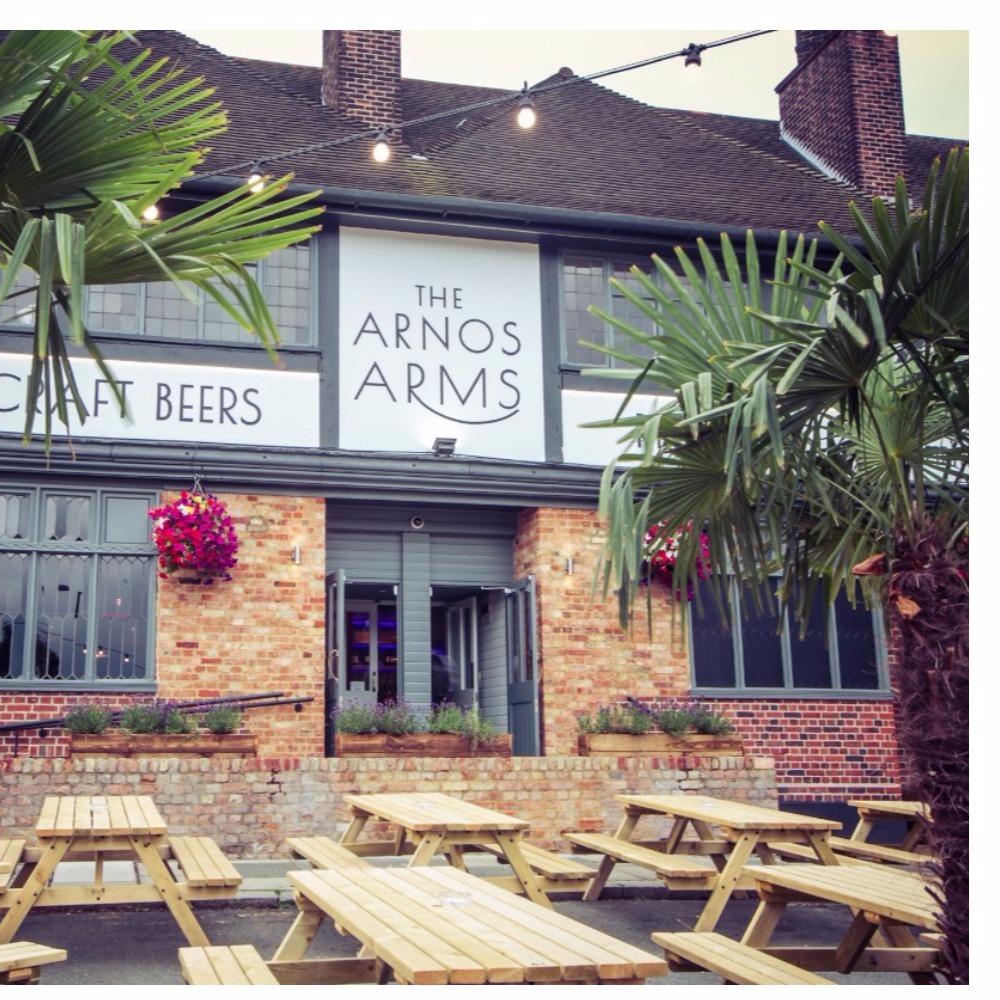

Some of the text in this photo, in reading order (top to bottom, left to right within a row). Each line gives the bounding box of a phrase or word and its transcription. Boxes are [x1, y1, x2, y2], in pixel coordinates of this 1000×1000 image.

[415, 284, 463, 310] THE
[352, 311, 522, 357] ARNOS
[155, 382, 263, 426] BEERS
[353, 361, 522, 426] ARMS
